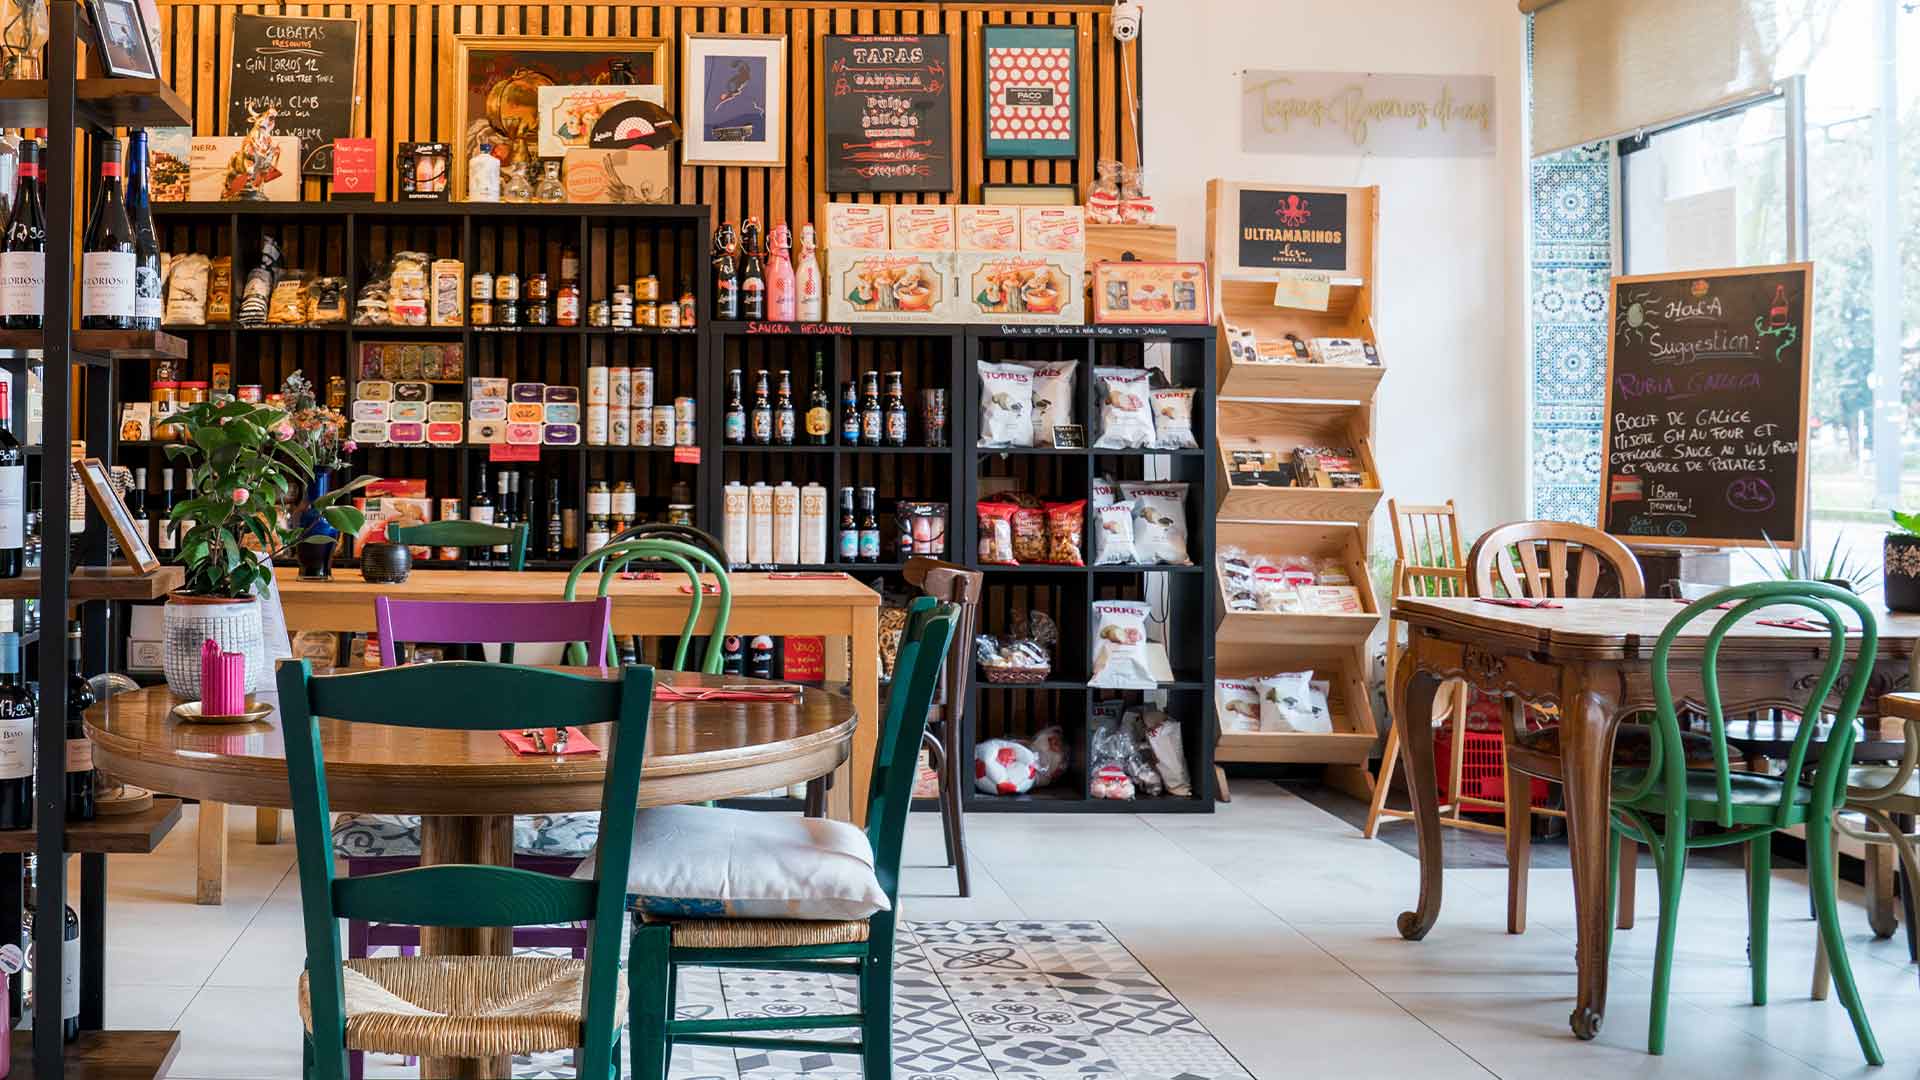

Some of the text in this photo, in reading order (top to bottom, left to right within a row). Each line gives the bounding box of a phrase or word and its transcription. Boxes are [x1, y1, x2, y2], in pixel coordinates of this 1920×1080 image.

[266, 25, 326, 39] CUBATAS
[853, 48, 924, 64] TAPAS
[305, 59, 319, 71] 12
[1244, 227, 1342, 243] ULTRAMARINOS
[984, 371, 1029, 383] TORRES
[1033, 368, 1062, 378] RRES
[1154, 391, 1191, 400] TORRES
[1667, 411, 1686, 426] DE
[1690, 428, 1707, 440] AU
[1710, 427, 1744, 440] FOUR
[1754, 423, 1777, 438] ET
[1672, 443, 1713, 460] SAUCE
[1720, 447, 1735, 457] AU
[1622, 463, 1636, 474] ET
[1685, 461, 1704, 472] DE
[1129, 487, 1180, 499] TORRES
[1095, 605, 1145, 617] TORRES
